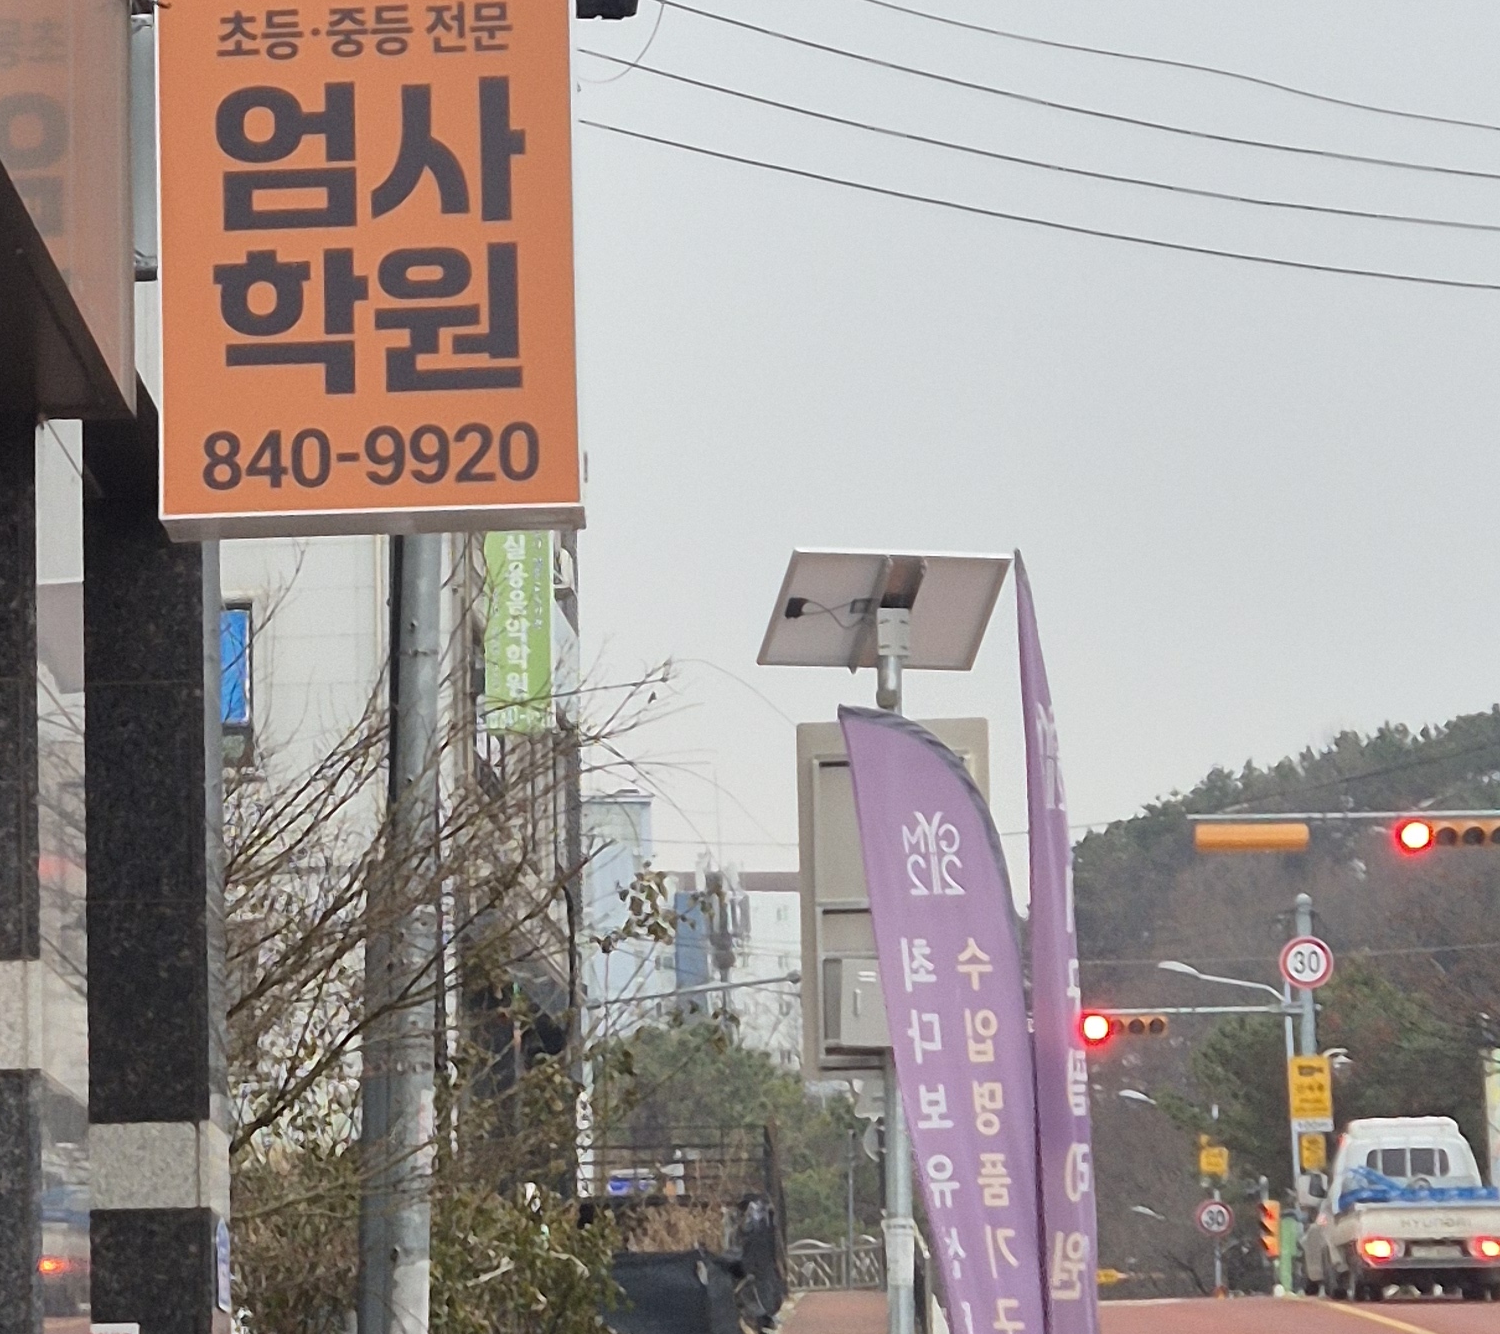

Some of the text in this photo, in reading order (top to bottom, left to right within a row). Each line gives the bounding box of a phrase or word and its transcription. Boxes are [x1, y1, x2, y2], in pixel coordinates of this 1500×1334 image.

[217, 0, 512, 61] 초등·중등 전문
[214, 75, 527, 233] 엄사
[212, 241, 524, 396] 학원
[202, 420, 539, 492] 840-9920
[1293, 950, 1321, 975] 30
[1203, 1209, 1226, 1227] 30
